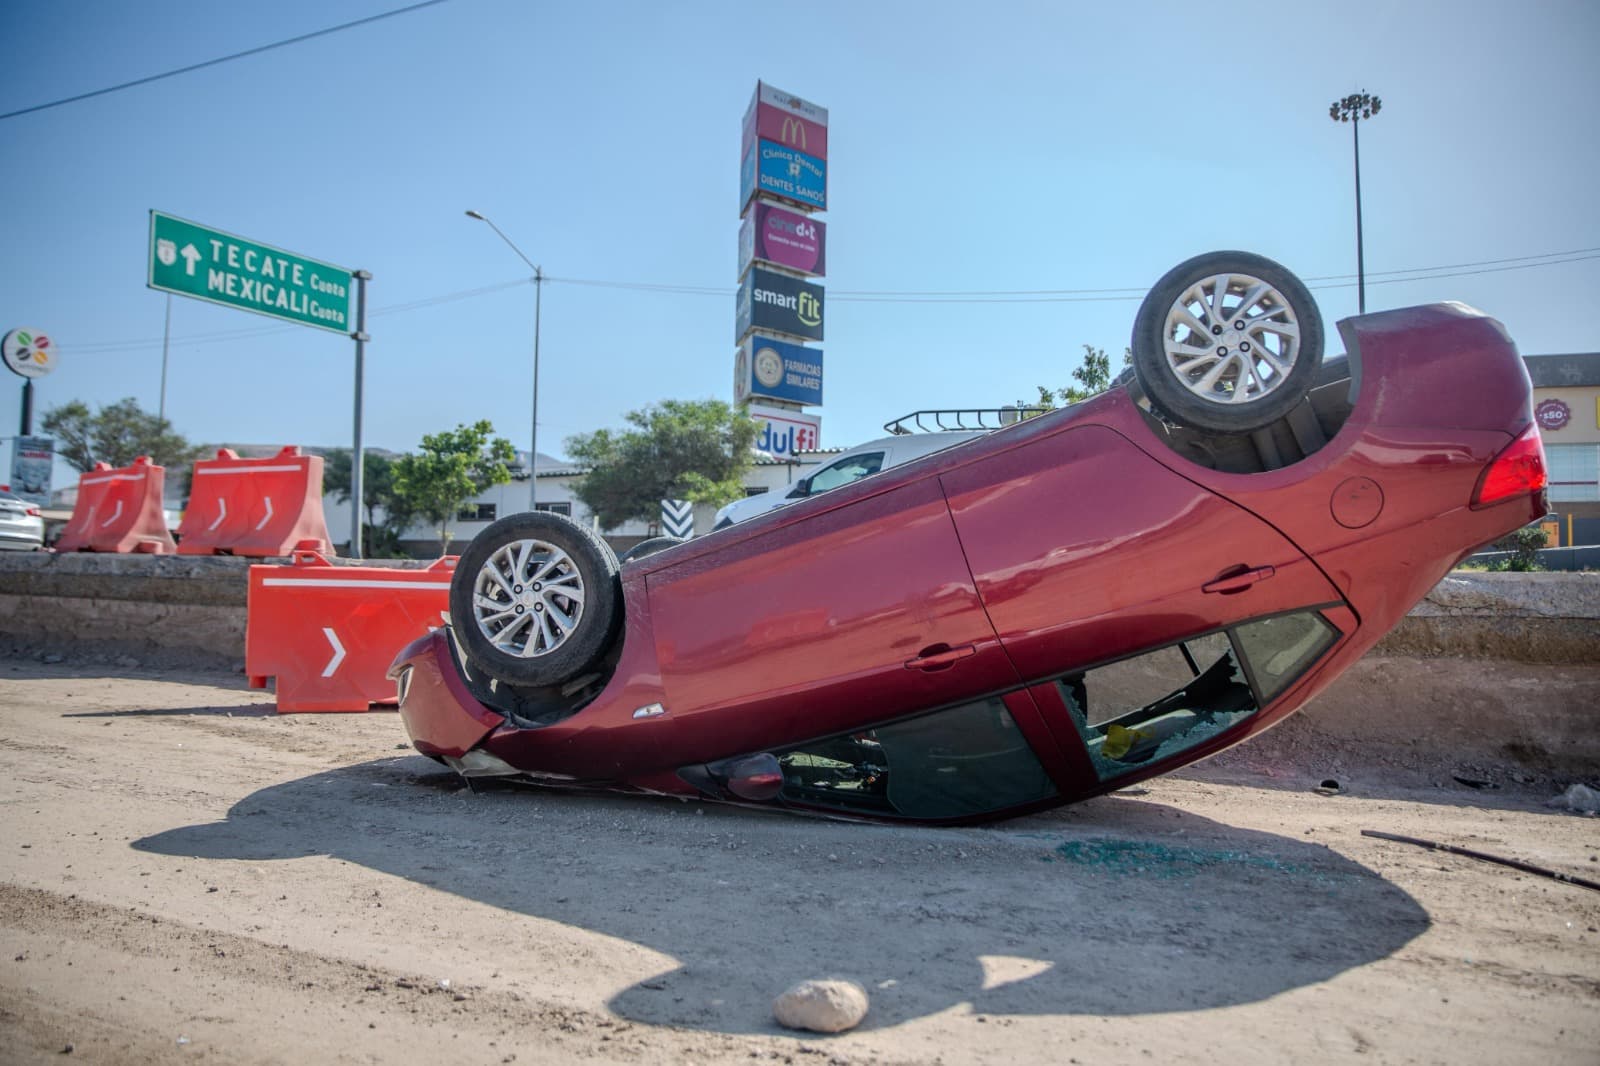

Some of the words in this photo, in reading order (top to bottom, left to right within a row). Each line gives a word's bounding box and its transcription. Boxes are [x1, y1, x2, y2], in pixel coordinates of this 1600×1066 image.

[761, 173, 794, 192] DIENTES
[796, 185, 825, 201] SANOS
[209, 239, 304, 286] TECATE
[309, 273, 346, 298] Cuota
[207, 268, 308, 315] MEXICALI
[309, 300, 346, 324] Cuota
[753, 288, 798, 311] smart
[798, 291, 821, 320] fit
[784, 359, 822, 377] FARMACIAS
[786, 373, 820, 390] SIMILARES
